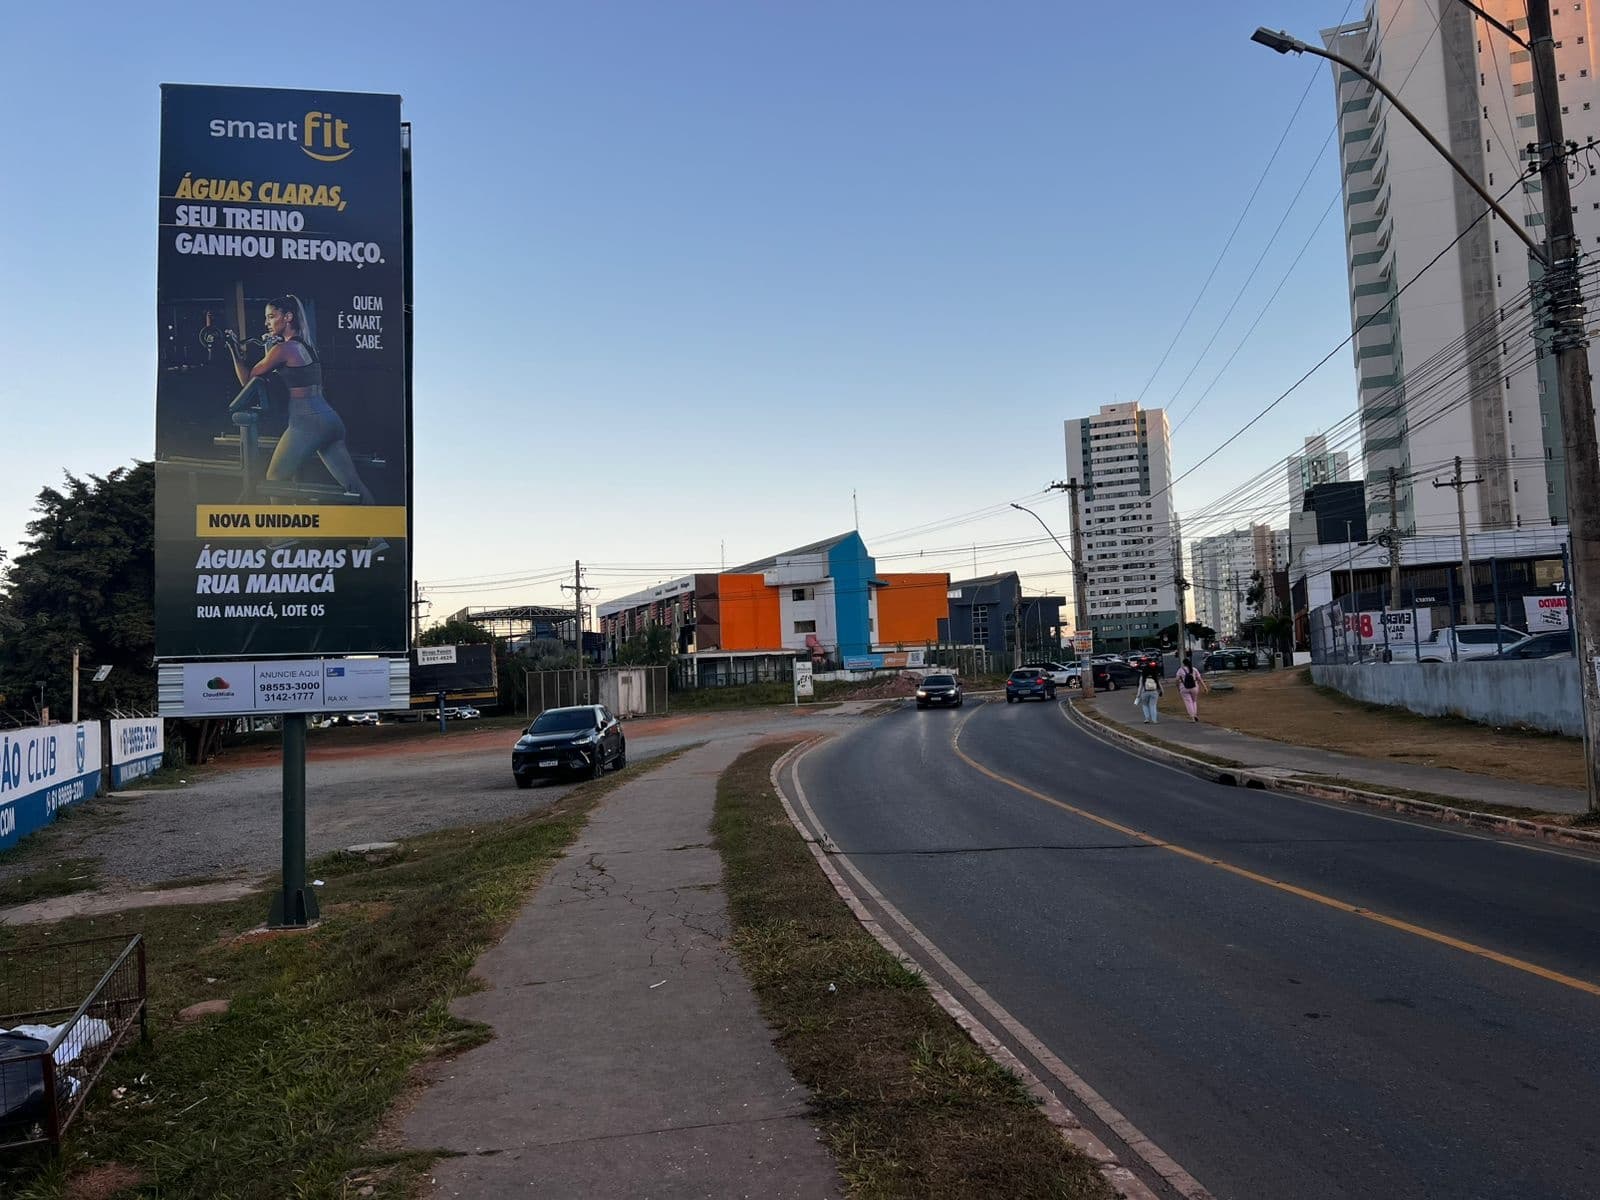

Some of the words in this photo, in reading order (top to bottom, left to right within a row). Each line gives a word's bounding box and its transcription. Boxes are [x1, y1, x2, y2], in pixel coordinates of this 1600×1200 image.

[209, 119, 298, 141] smart
[304, 111, 350, 149] fit
[174, 172, 253, 201] ÁGUAS
[258, 181, 348, 212] CLARAS,
[175, 205, 217, 227] SEU
[223, 207, 305, 232] TREINO
[175, 233, 275, 259] GANHOU
[281, 238, 386, 269] REFORÇO.
[353, 296, 383, 312] QUEM
[338, 311, 345, 329] É
[347, 314, 383, 333] SMART,
[355, 334, 384, 350] SABE.
[208, 514, 251, 528] NOVA
[254, 514, 320, 528] UNIDADE
[195, 543, 266, 569] ÁGUAS
[270, 549, 347, 569] CLARAS
[352, 549, 372, 569] VI
[196, 574, 240, 594] RUA
[245, 569, 335, 594] MANACÁ
[197, 605, 221, 618] RUA
[224, 602, 278, 619] MANACÁ,
[281, 604, 308, 617] LOTE
[310, 604, 325, 617] 05
[259, 670, 297, 679] ANUNCIE
[299, 670, 320, 678] AQUI
[259, 682, 320, 692] 98553-3000
[264, 692, 314, 702] 3142-1777
[27, 735, 57, 783] CLUB
